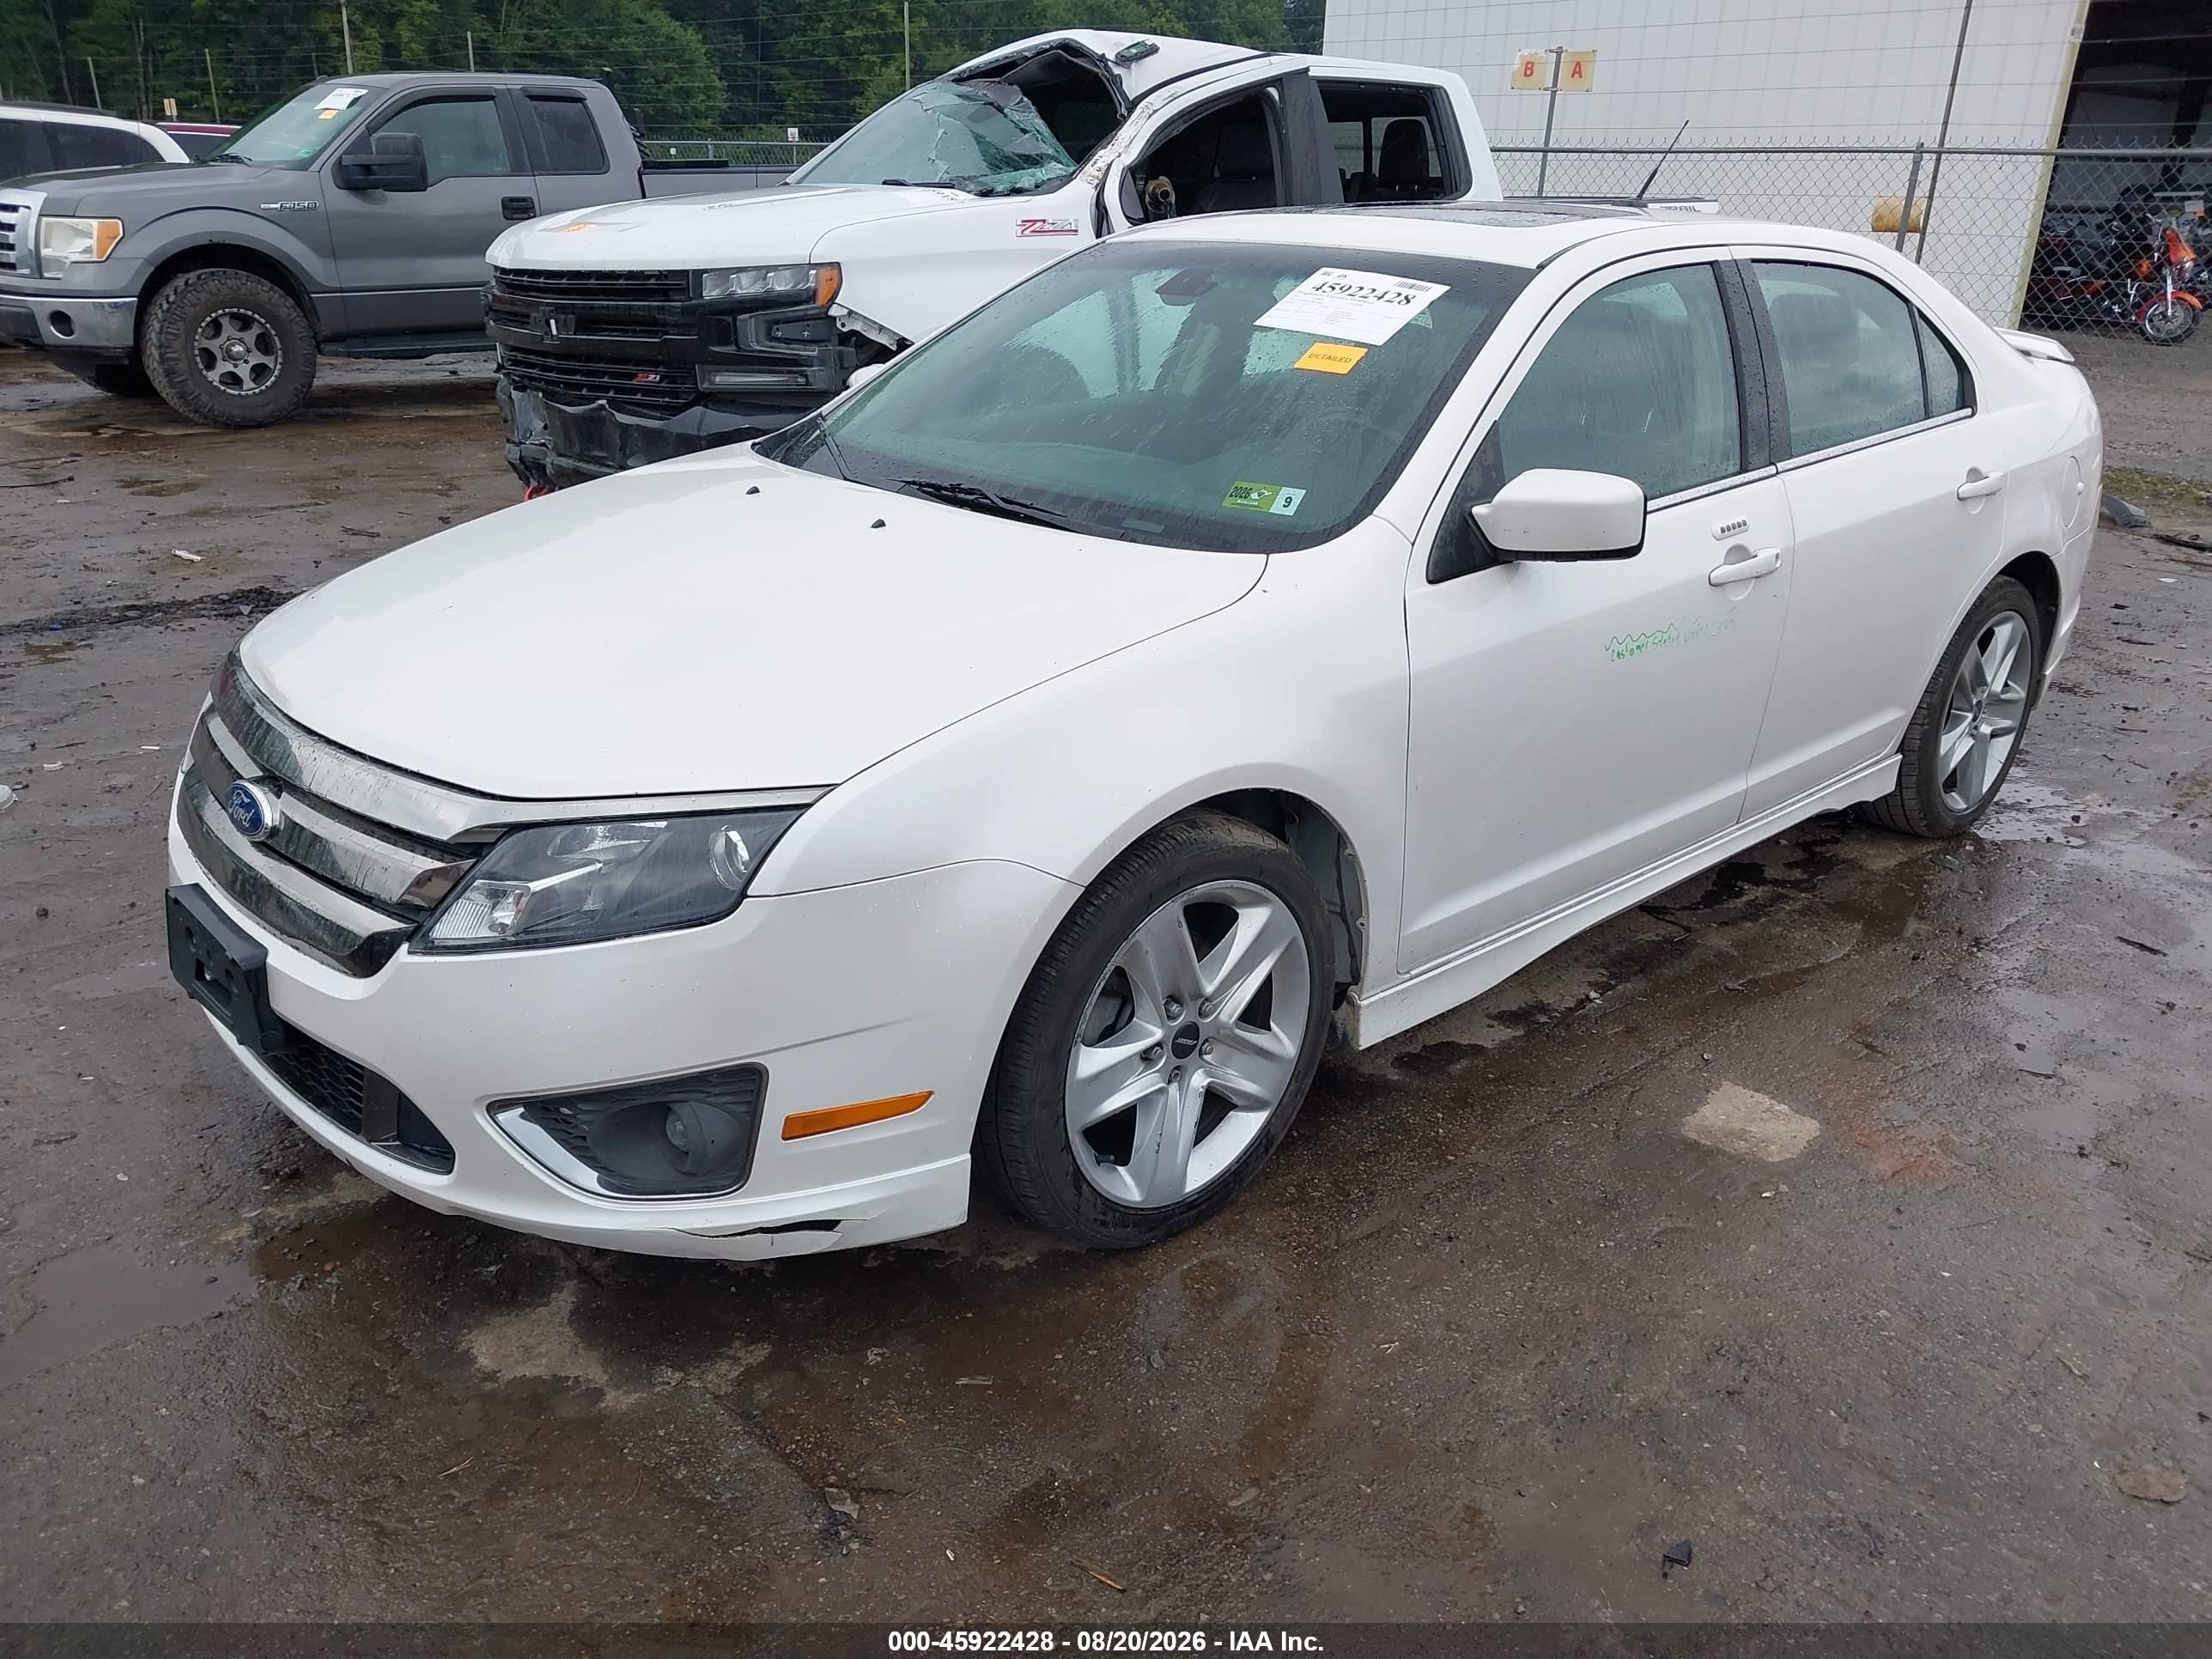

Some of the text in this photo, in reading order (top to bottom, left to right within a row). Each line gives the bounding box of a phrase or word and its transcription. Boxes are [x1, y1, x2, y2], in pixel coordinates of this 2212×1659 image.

[1523, 61, 1534, 77] B
[1571, 61, 1583, 78] A
[1312, 281, 1417, 307] 45922428
[1308, 353, 1352, 363] DETAILED
[1229, 485, 1253, 499] 2026
[1282, 495, 1294, 508] 9
[228, 789, 256, 828] Ford
